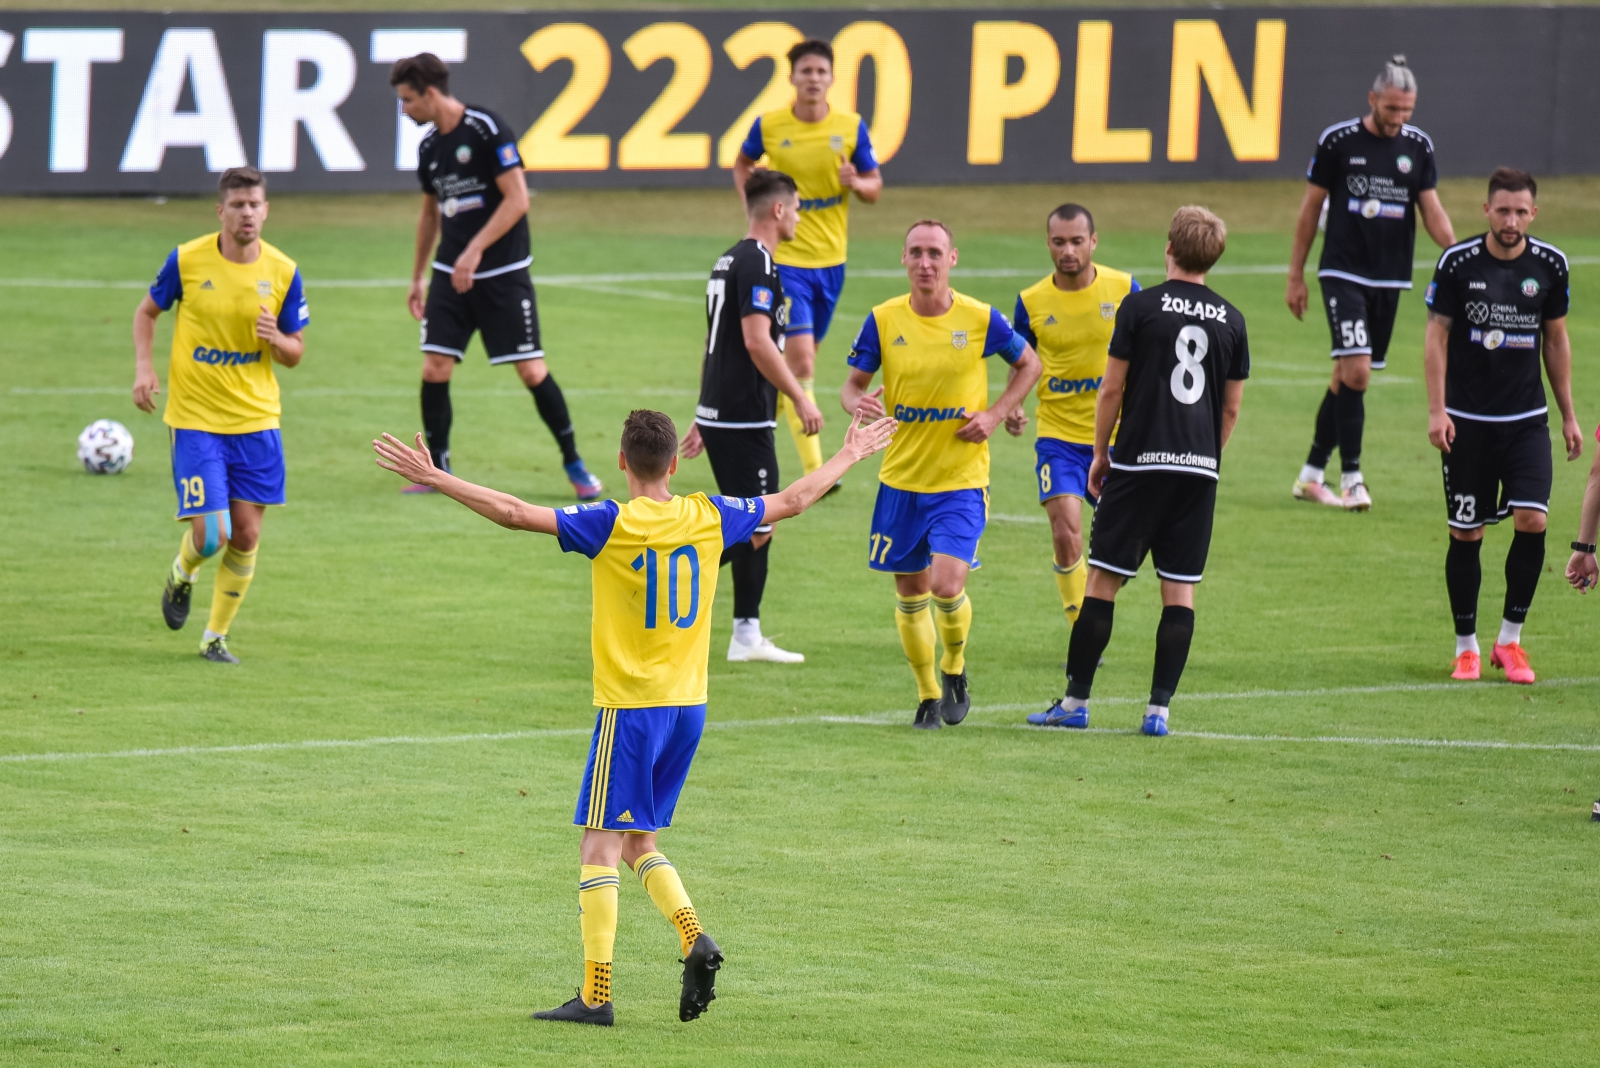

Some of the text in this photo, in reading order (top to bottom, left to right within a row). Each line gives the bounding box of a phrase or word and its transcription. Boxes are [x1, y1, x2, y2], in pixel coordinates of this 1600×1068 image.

[0, 28, 467, 172] TART
[967, 19, 1287, 165] PLN
[1161, 293, 1227, 323] ŻOŁĄDŹ
[1341, 319, 1367, 348] 56
[1170, 324, 1209, 405] 8
[1048, 376, 1103, 394] GDYN
[1041, 463, 1051, 494] 8
[1454, 494, 1476, 523] 23
[870, 532, 893, 565] 17
[630, 544, 700, 629] 10
